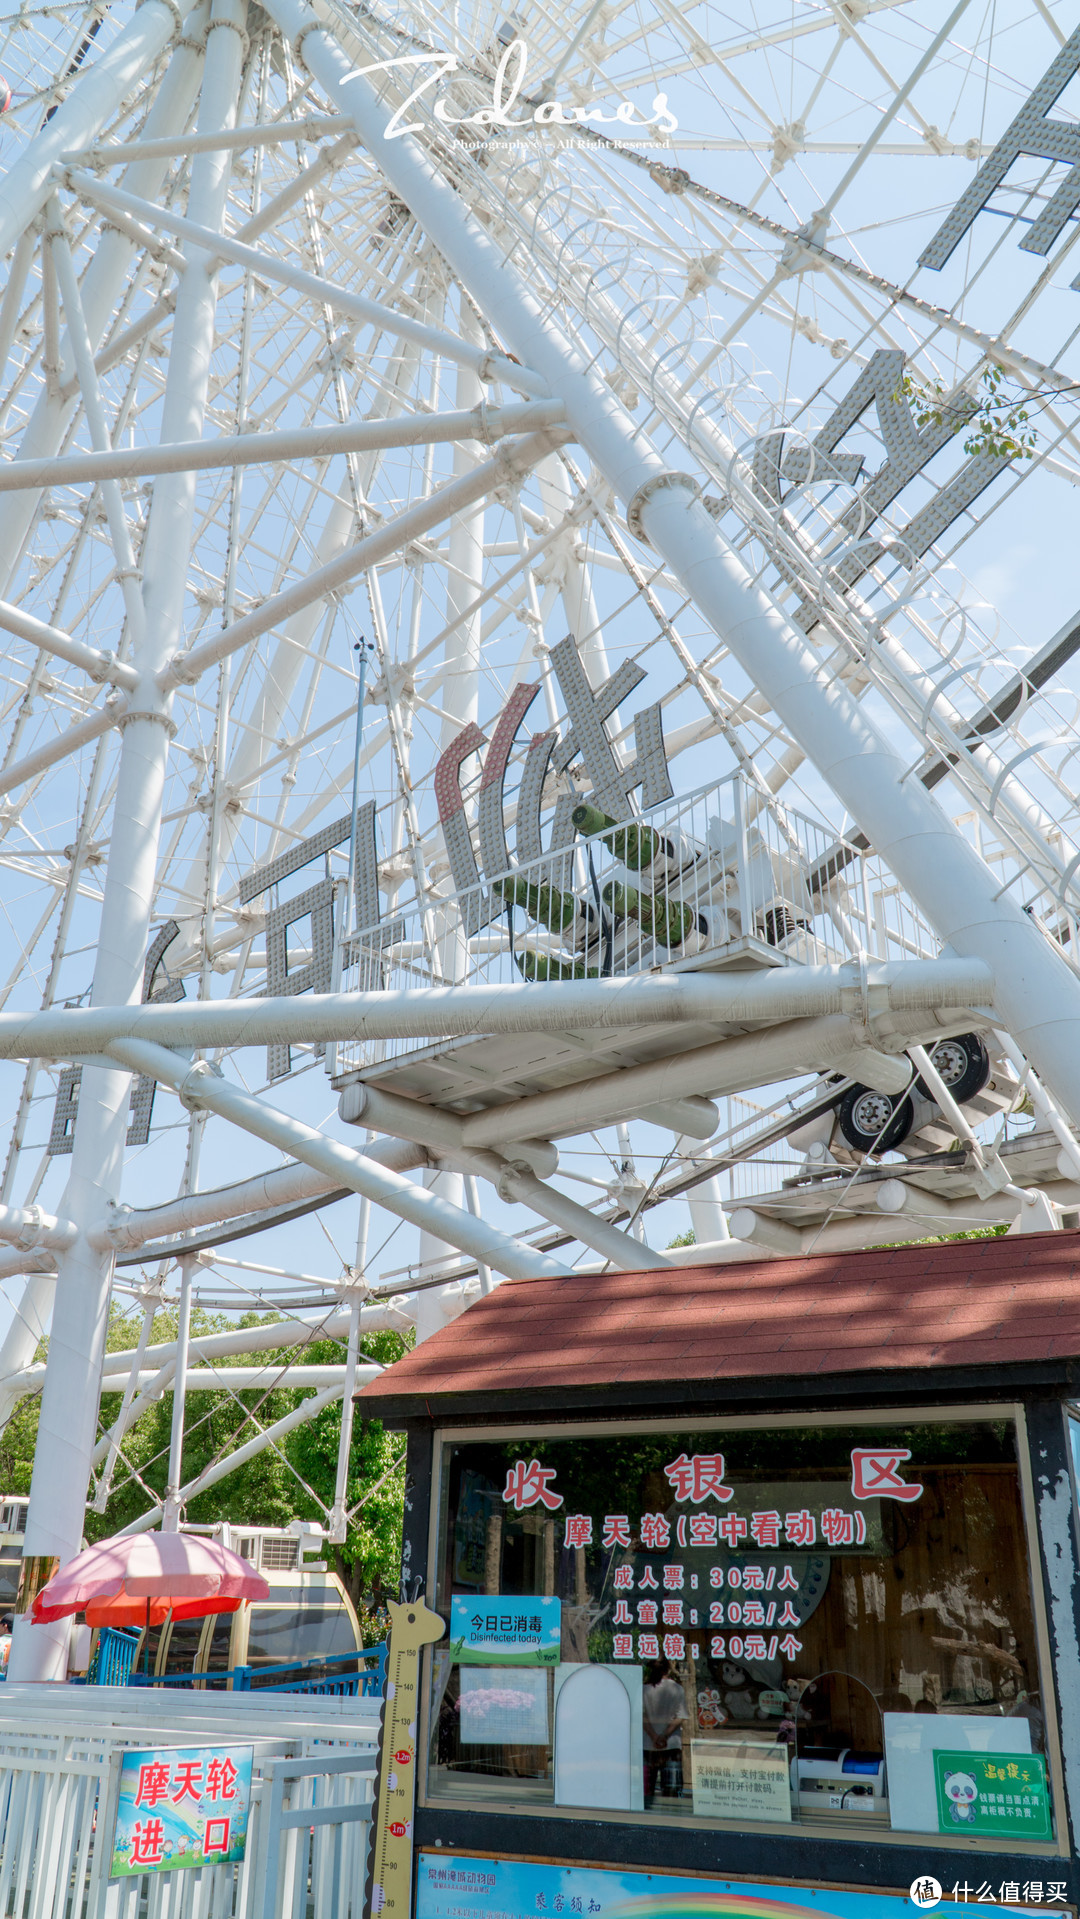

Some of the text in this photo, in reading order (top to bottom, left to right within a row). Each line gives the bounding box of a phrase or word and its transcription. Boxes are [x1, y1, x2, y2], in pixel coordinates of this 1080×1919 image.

[502, 1448, 924, 1510] 收银区
[471, 1614, 543, 1633] 今日已消毒
[470, 1632, 542, 1646] Disinfected today
[406, 1649, 416, 1657] 150
[400, 1717, 411, 1725] 130
[396, 1752, 411, 1761] 1.2m
[982, 1762, 1031, 1782] 温馨提示
[133, 1756, 239, 1808] 摩天轮
[395, 1789, 405, 1797] 110
[392, 1824, 404, 1834] 1m
[128, 1816, 231, 1868] 进口
[389, 1861, 397, 1870] 90
[387, 1899, 395, 1907] 80
[534, 1891, 602, 1915] 乘客须知
